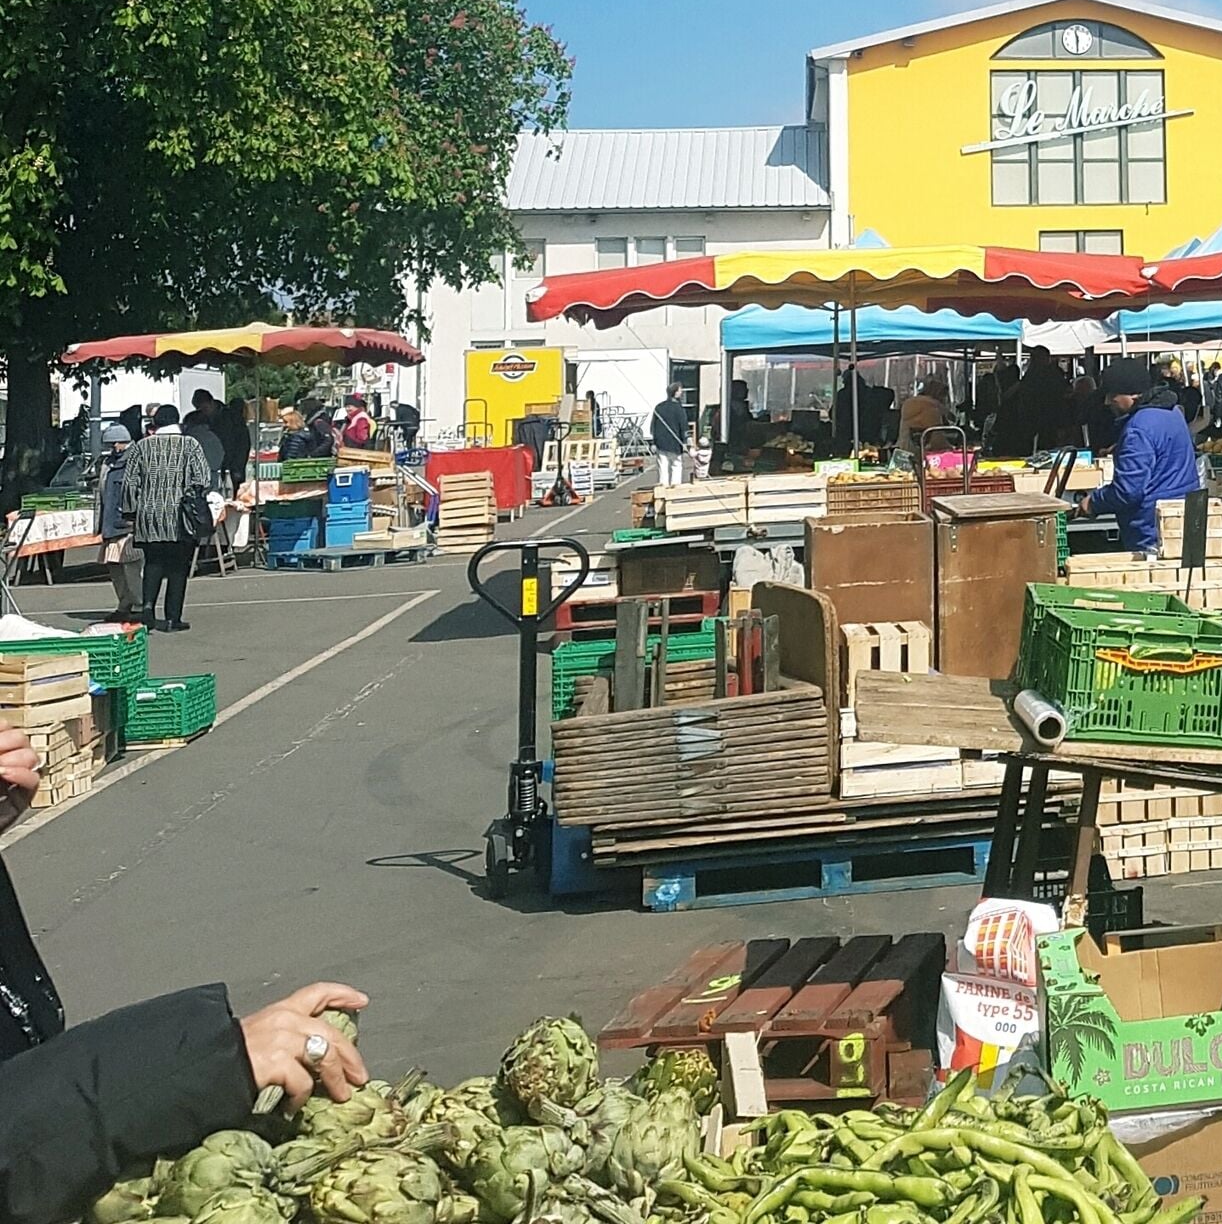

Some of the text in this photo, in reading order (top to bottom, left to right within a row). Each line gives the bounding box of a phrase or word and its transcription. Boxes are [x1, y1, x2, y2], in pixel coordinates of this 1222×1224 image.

[994, 79, 1044, 139] Le
[955, 980, 1011, 1000] FARINE
[1015, 991, 1030, 1003] de
[977, 1002, 1033, 1021] type 55
[994, 1022, 1017, 1034] 000
[1124, 1082, 1166, 1095] COSTA
[1173, 1077, 1215, 1090] RICAN
